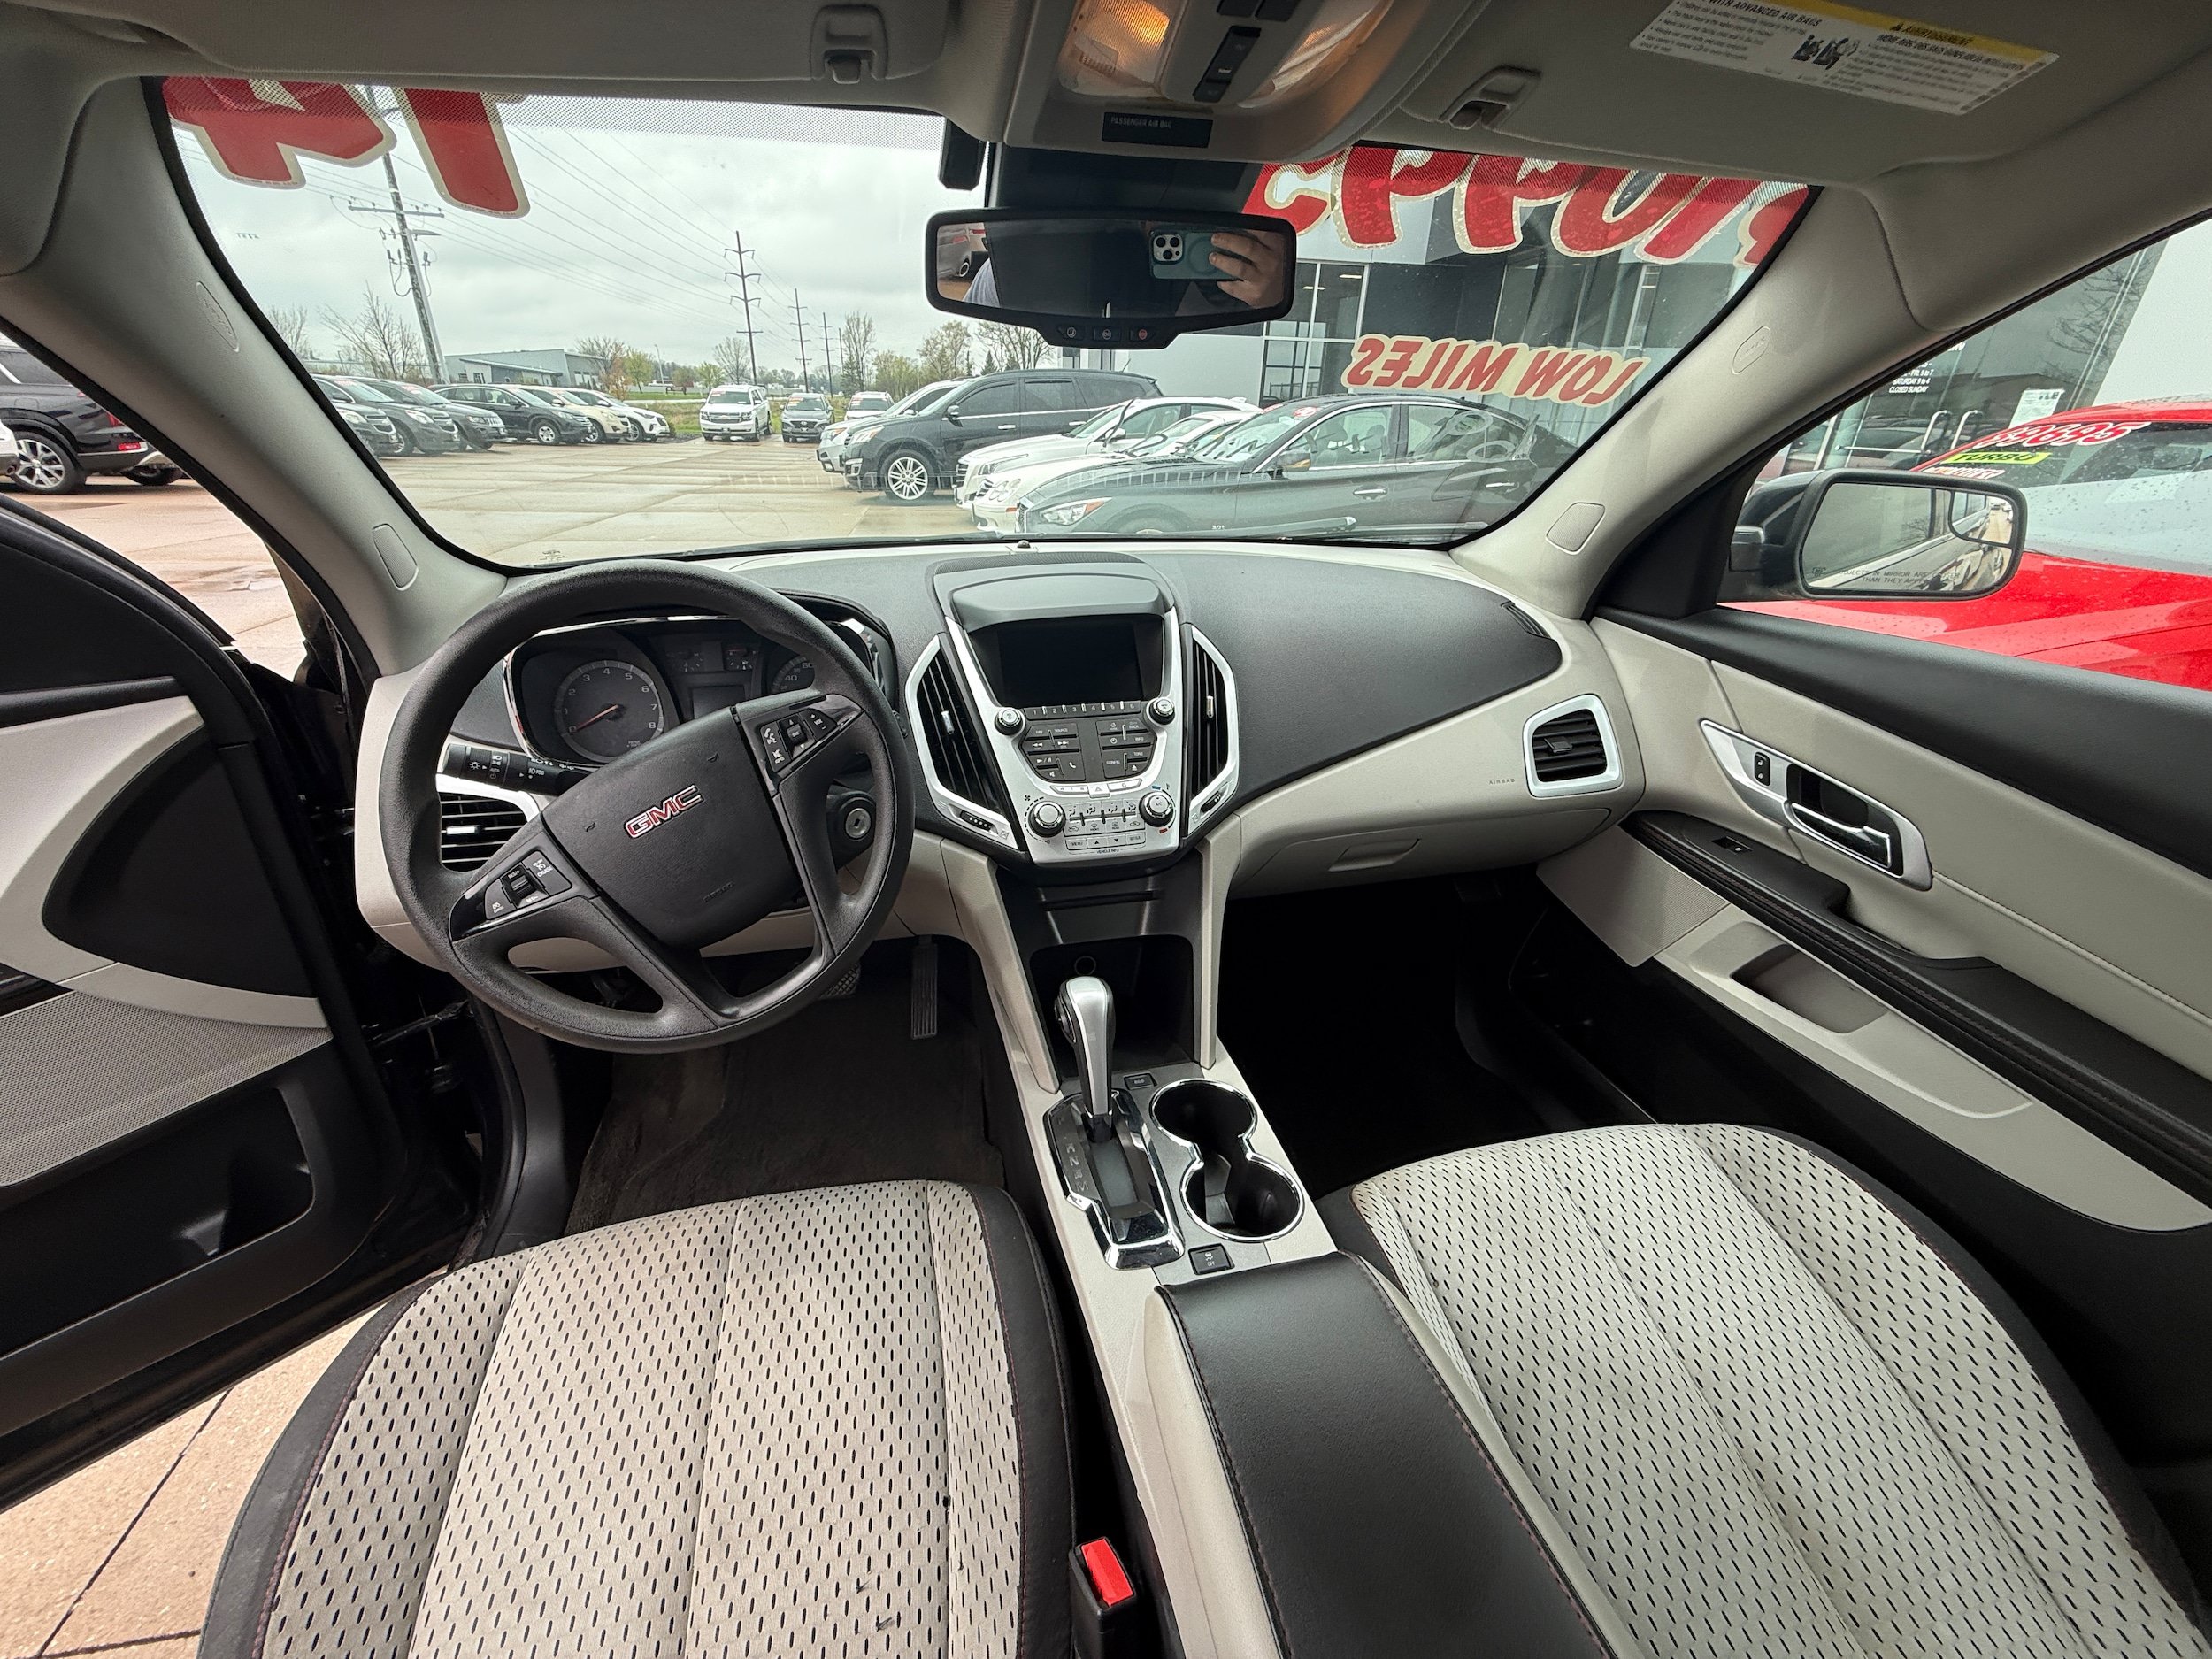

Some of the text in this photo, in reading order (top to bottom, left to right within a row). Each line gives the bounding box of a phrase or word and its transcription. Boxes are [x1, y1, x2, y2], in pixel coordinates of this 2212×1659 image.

[1733, 1, 1780, 17] ADVANCED
[1952, 453, 2036, 462] TURBO
[625, 784, 703, 838] GMC
